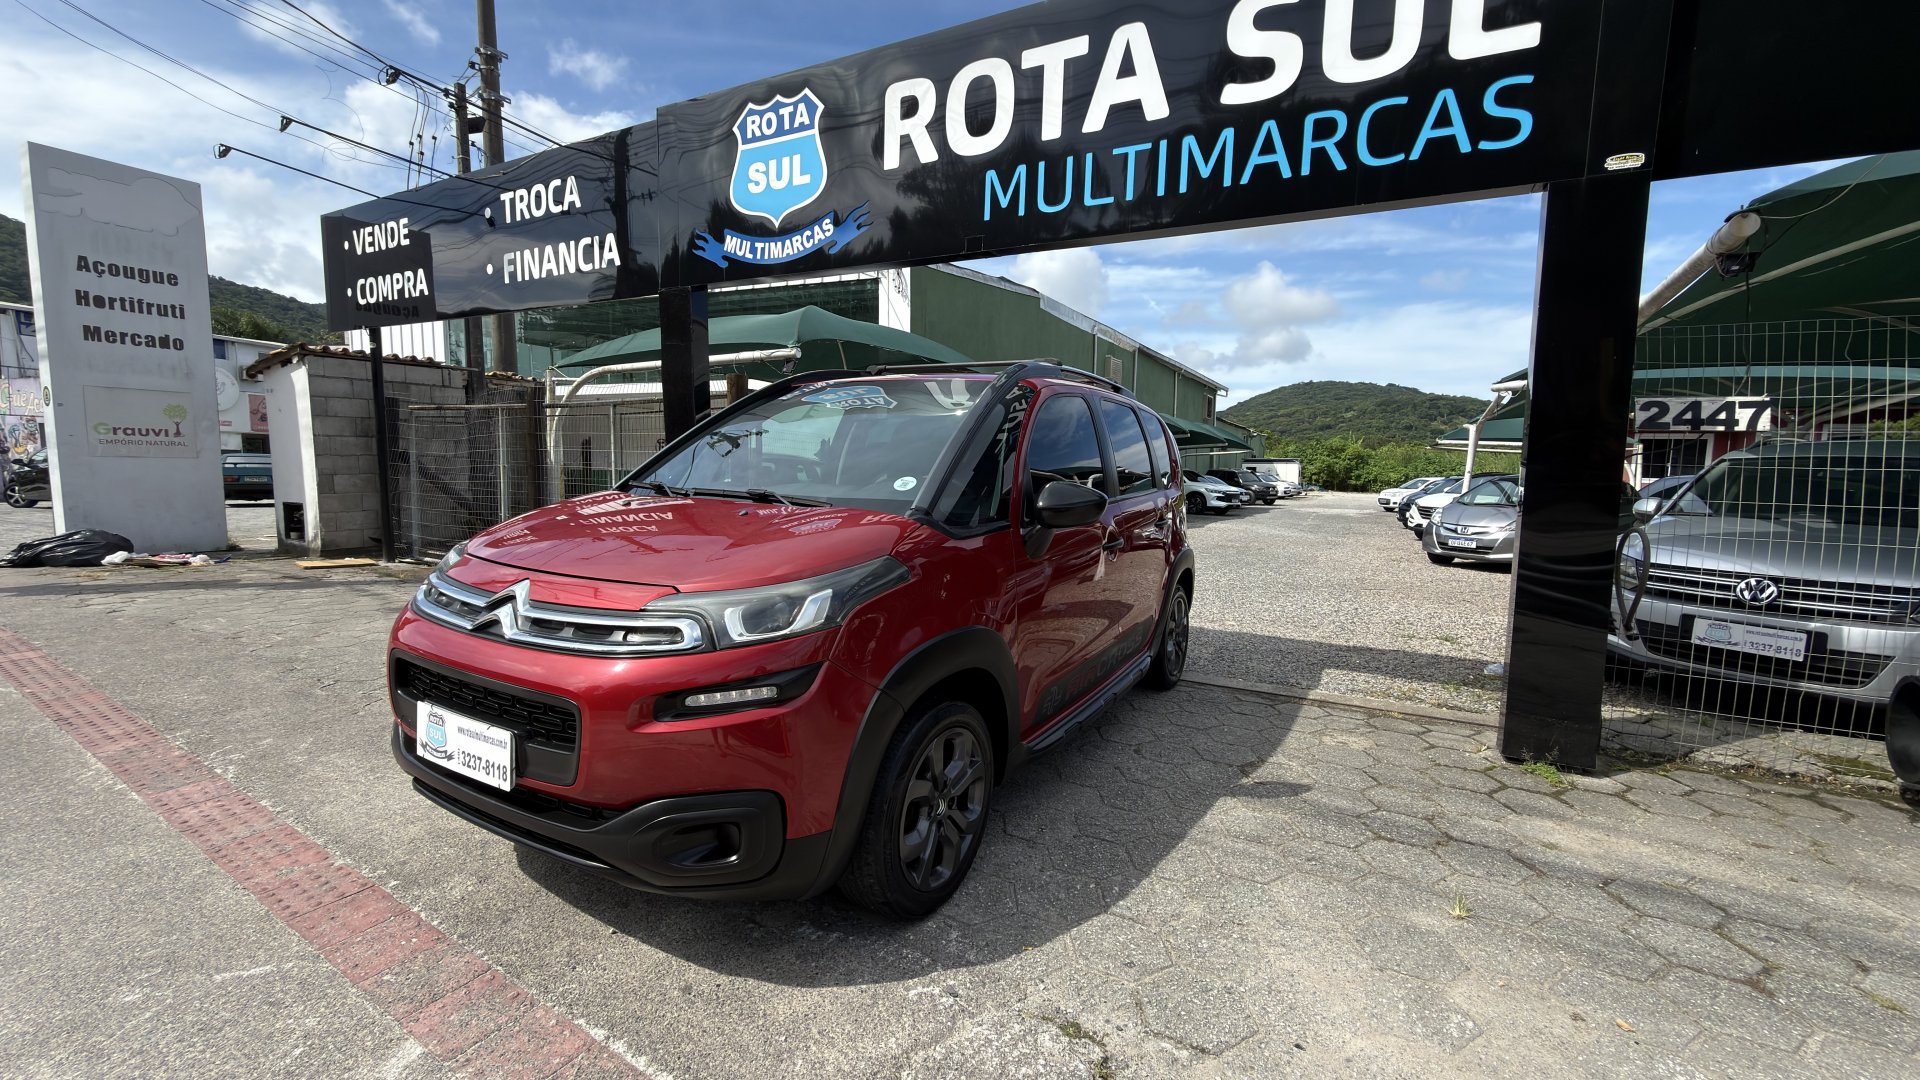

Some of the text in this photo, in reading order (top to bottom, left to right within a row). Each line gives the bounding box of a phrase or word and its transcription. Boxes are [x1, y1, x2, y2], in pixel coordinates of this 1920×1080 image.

[883, 21, 1170, 171] ROTA
[746, 102, 811, 139] ROTA
[983, 75, 1535, 221] MULTIMARCAS
[747, 154, 811, 194] SUL
[500, 175, 582, 224] TROCA
[352, 217, 410, 255] VENDE
[724, 218, 834, 260] MULTIMARCAS
[76, 254, 179, 287] Açougue
[503, 232, 621, 284] FINANCIA
[75, 289, 186, 320] Hortifruti
[356, 267, 429, 305] COMPRA
[82, 324, 185, 351] Mercado
[93, 422, 170, 438] Grauvi
[1638, 400, 1775, 431] 2447
[98, 438, 143, 446] EMPÓRIO
[429, 728, 443, 741] SUL
[461, 750, 508, 782] 3237-8118
